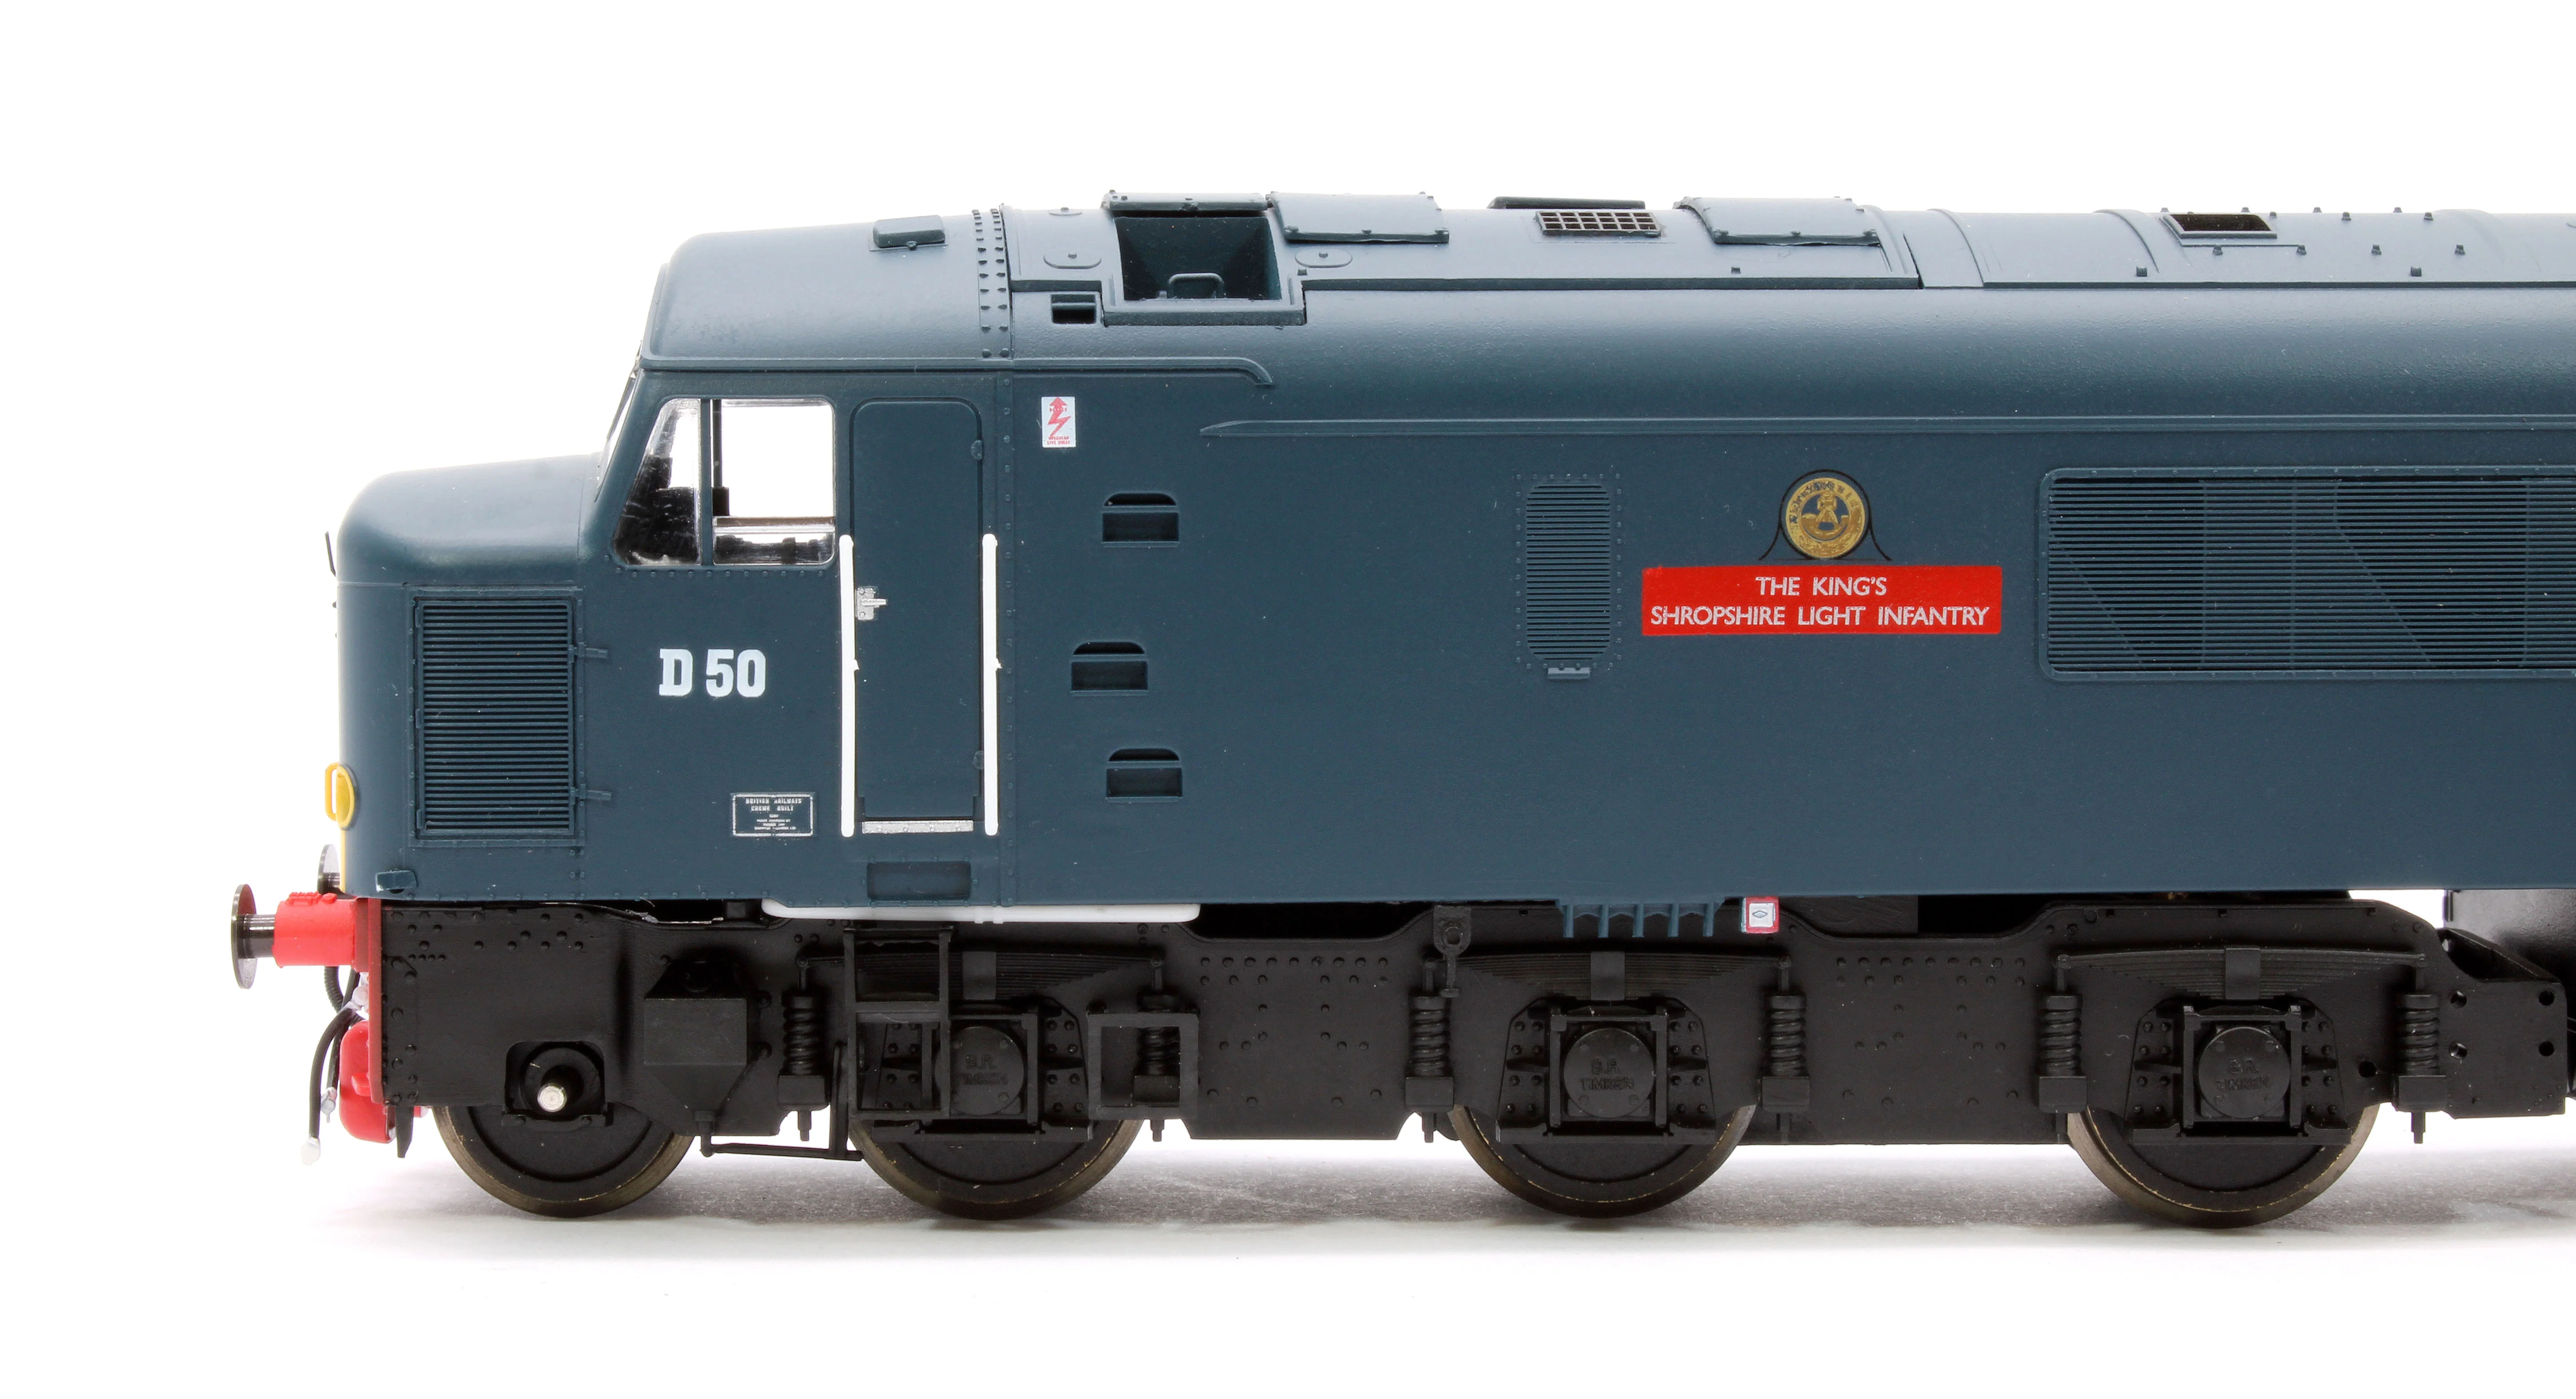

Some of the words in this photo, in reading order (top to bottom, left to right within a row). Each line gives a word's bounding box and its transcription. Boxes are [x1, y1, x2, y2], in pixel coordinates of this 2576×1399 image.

[1756, 577, 1800, 595] THE
[1813, 577, 1886, 595] KING'S
[1651, 606, 1785, 625] SHROPSHIRE
[1798, 607, 1866, 625] LIGHT
[1878, 607, 1989, 625] INFANTRY
